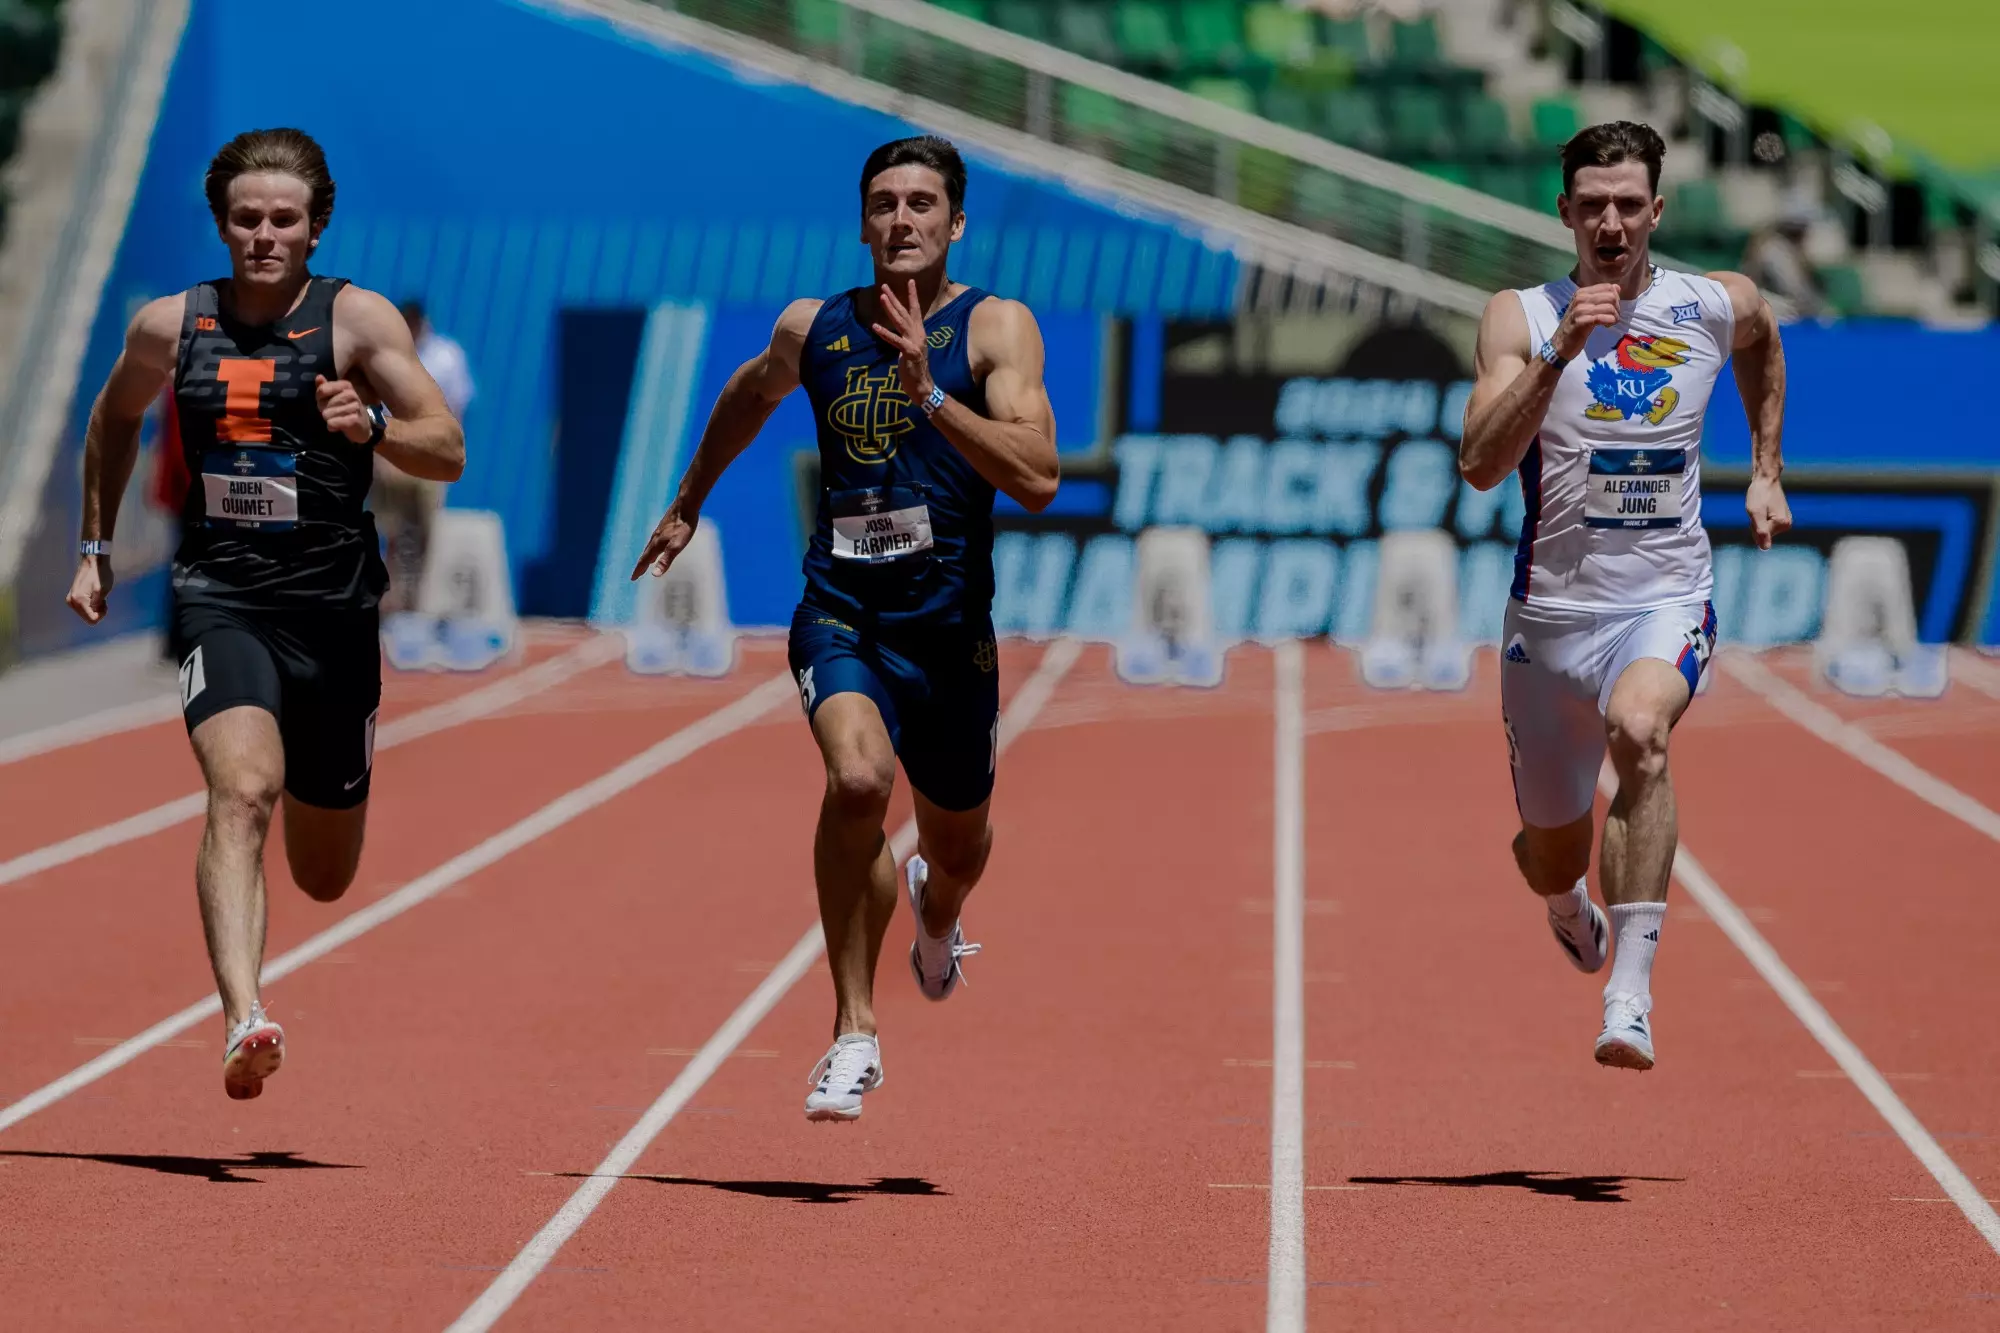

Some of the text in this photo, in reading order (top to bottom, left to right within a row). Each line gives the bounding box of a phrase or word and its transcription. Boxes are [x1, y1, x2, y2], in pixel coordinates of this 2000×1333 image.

[1616, 379, 1646, 398] KU
[229, 481, 263, 495] AIDEN
[1603, 480, 1671, 494] ALEXANDER
[222, 497, 274, 516] OUIMET
[1617, 498, 1657, 514] JUNG
[865, 517, 894, 533] JOSH
[853, 532, 913, 556] FARMER
